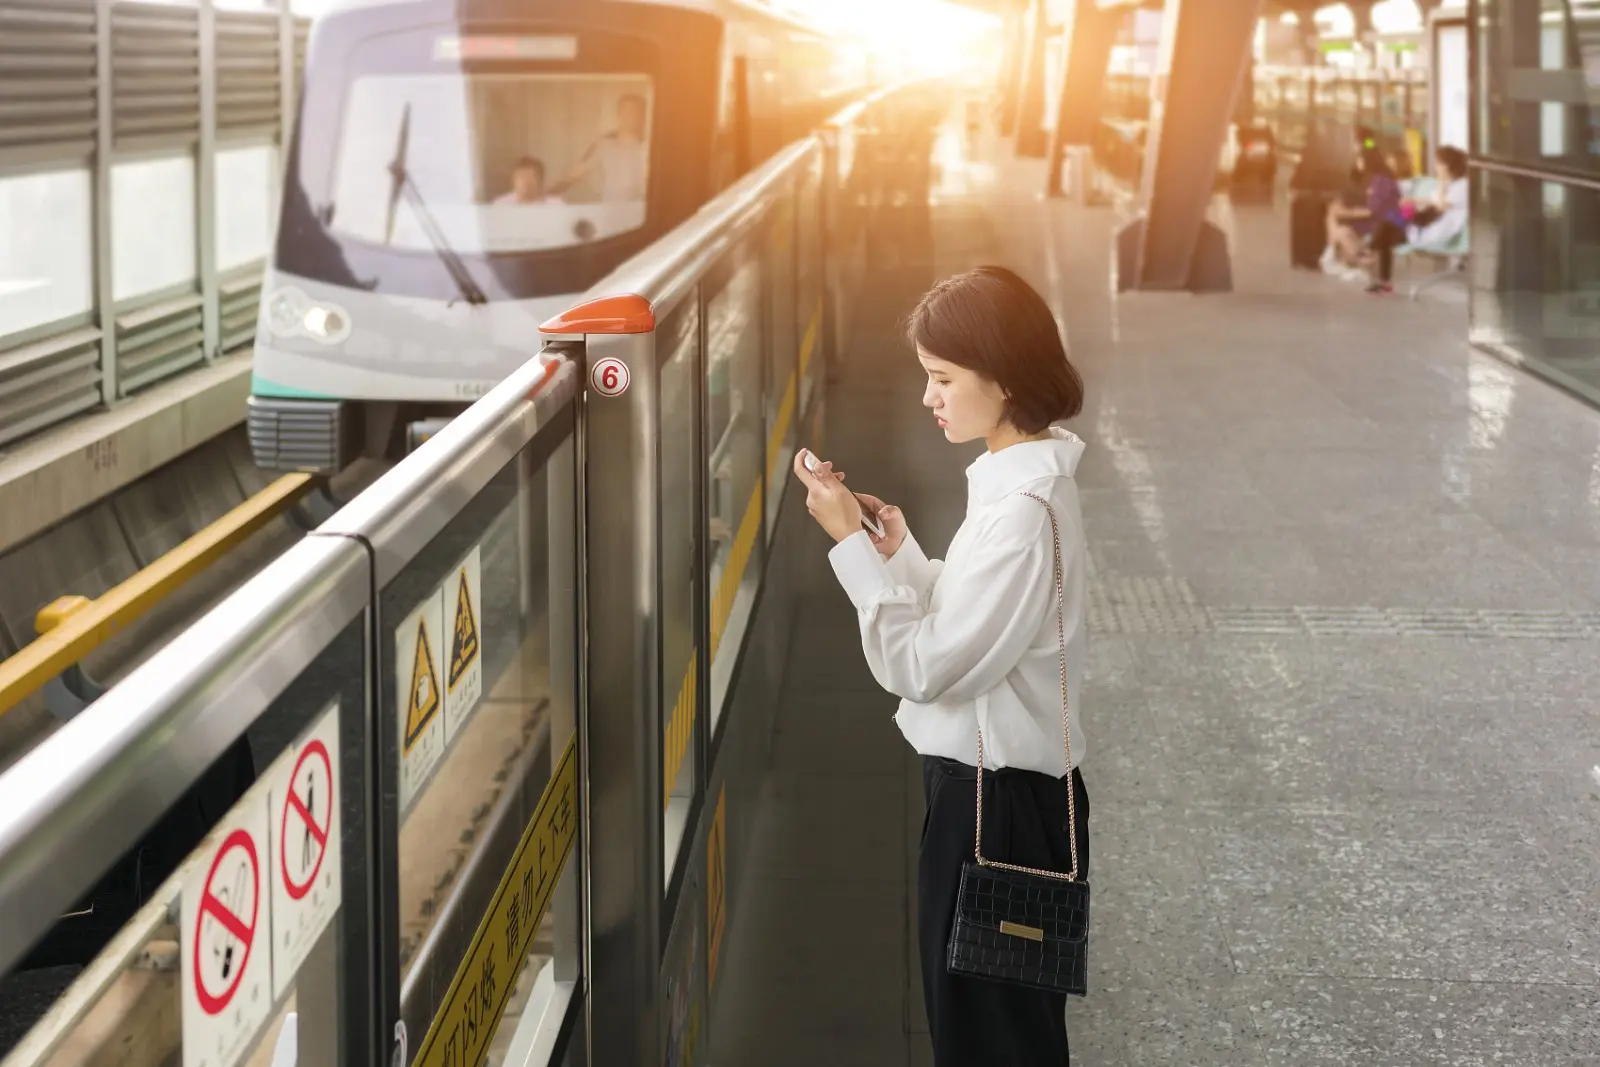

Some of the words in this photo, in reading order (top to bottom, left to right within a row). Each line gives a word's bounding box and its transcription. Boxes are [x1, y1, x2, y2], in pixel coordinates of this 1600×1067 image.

[602, 365, 618, 389] 6
[505, 783, 571, 962] 请勿上下车
